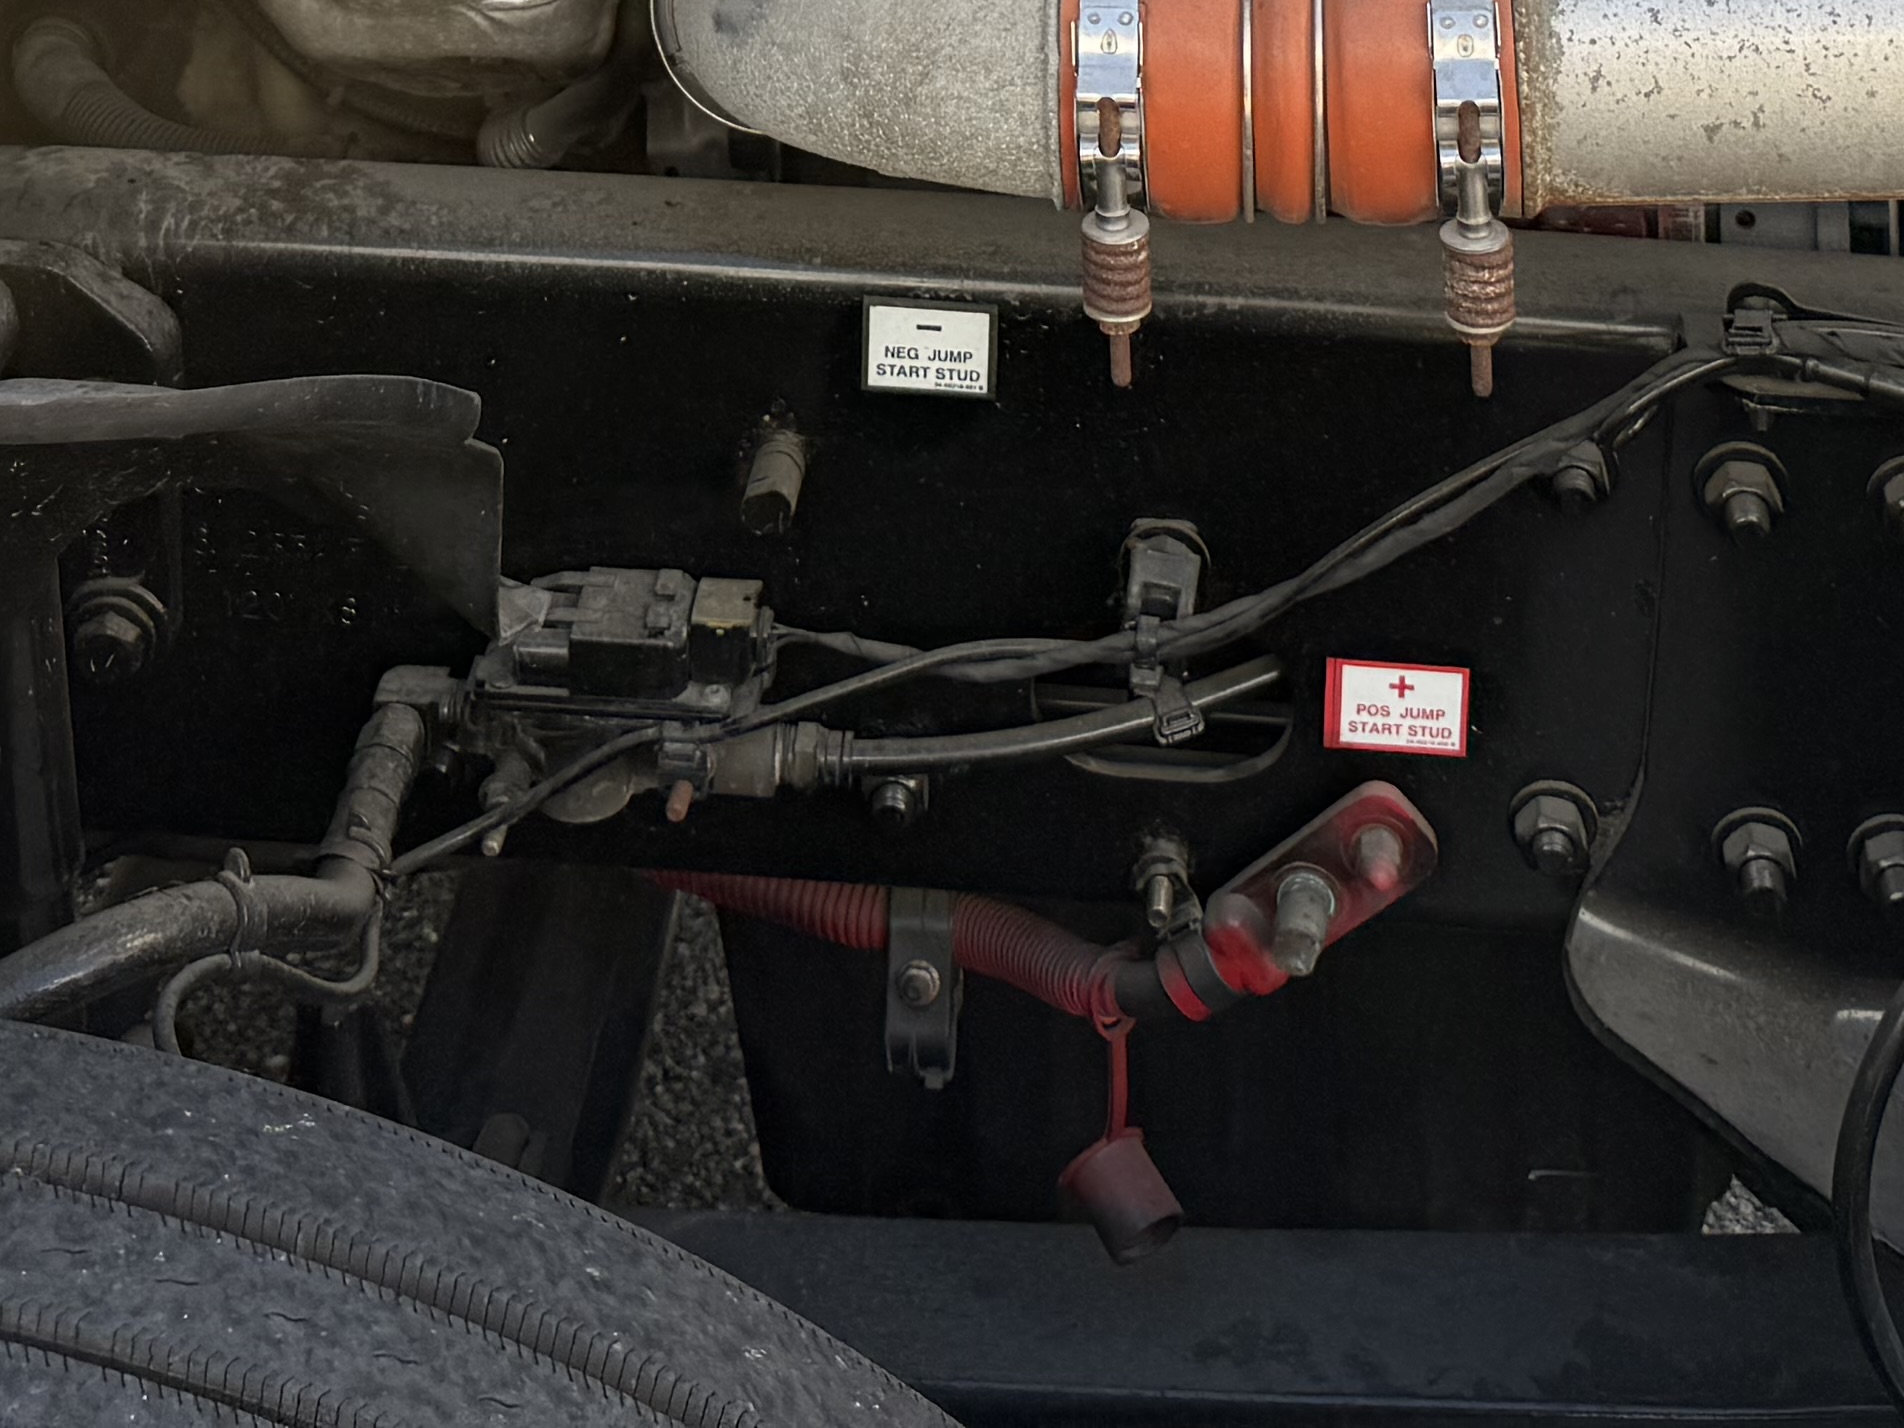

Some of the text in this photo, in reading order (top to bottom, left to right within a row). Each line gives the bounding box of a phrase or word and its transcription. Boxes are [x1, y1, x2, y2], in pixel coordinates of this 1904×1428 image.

[884, 345, 974, 364] NEG JUMP
[875, 363, 981, 383] START STUD
[1356, 703, 1446, 721] POS JUMP
[1348, 720, 1453, 739] START STUD
